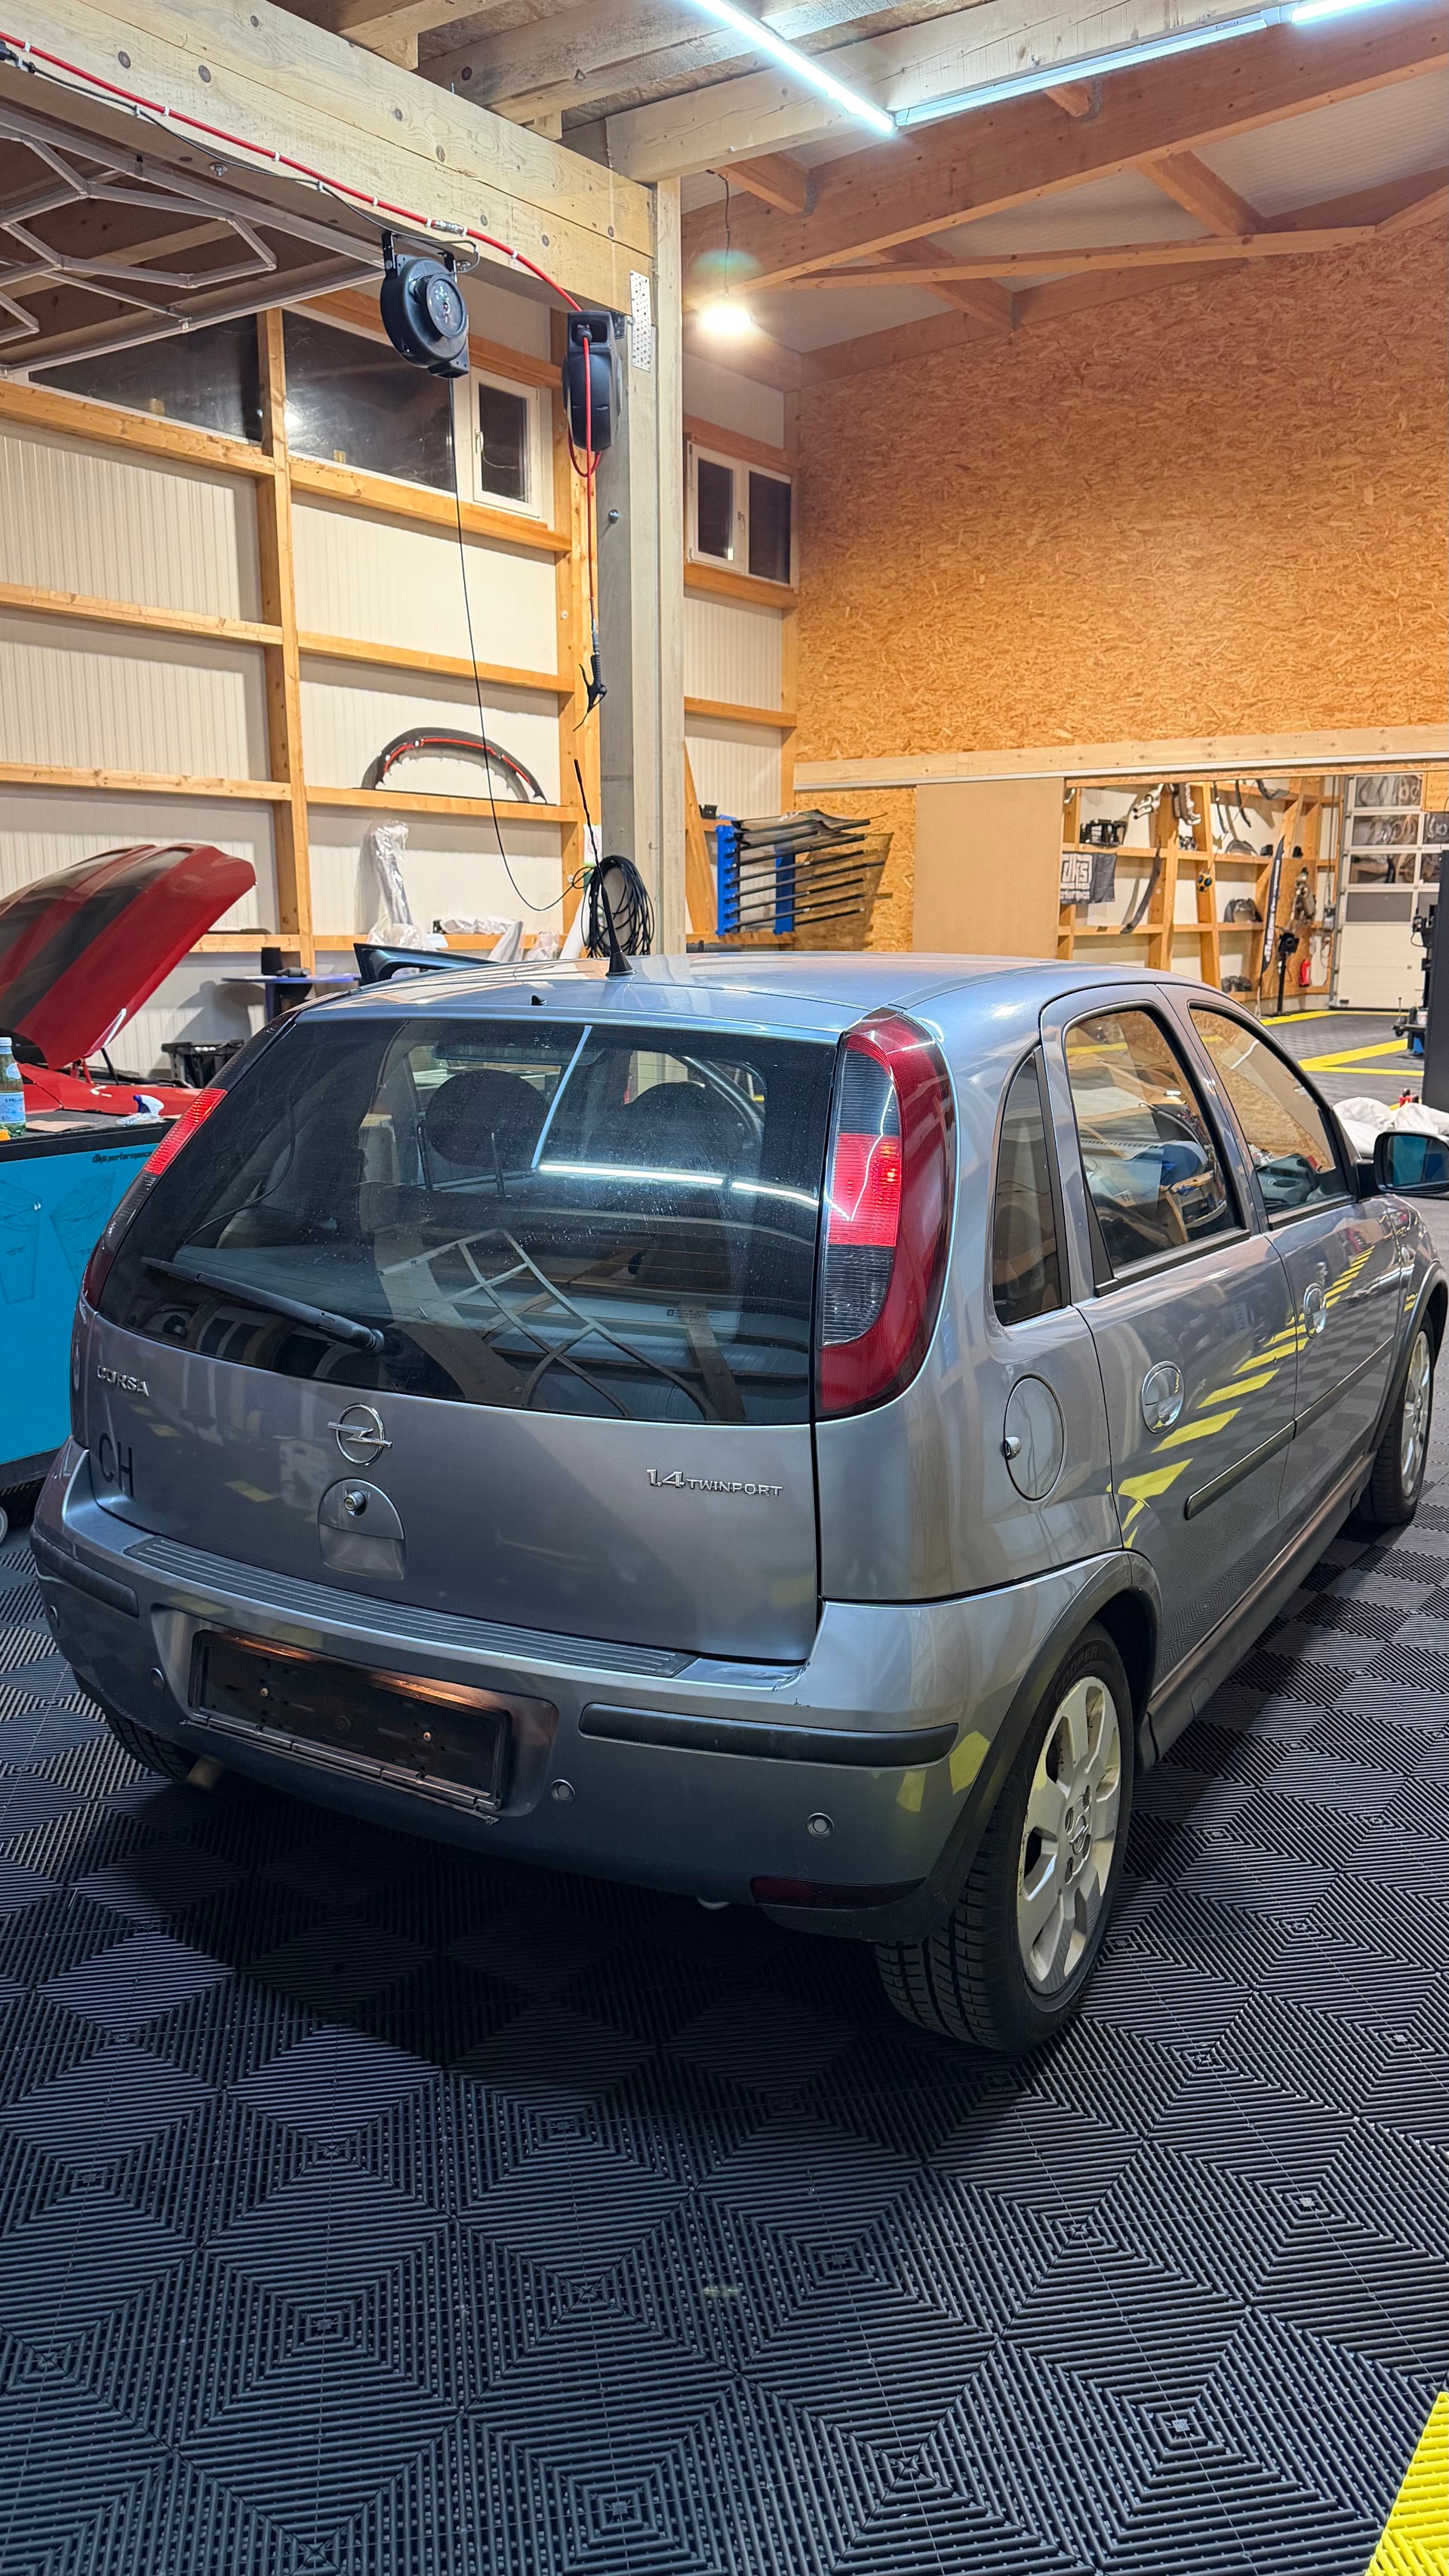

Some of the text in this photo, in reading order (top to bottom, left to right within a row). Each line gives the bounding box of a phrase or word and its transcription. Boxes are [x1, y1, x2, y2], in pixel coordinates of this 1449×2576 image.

[97, 1365, 150, 1397] CORSA
[99, 1432, 134, 1498] CH
[647, 1469, 783, 1497] 1.4 TWINPORT
